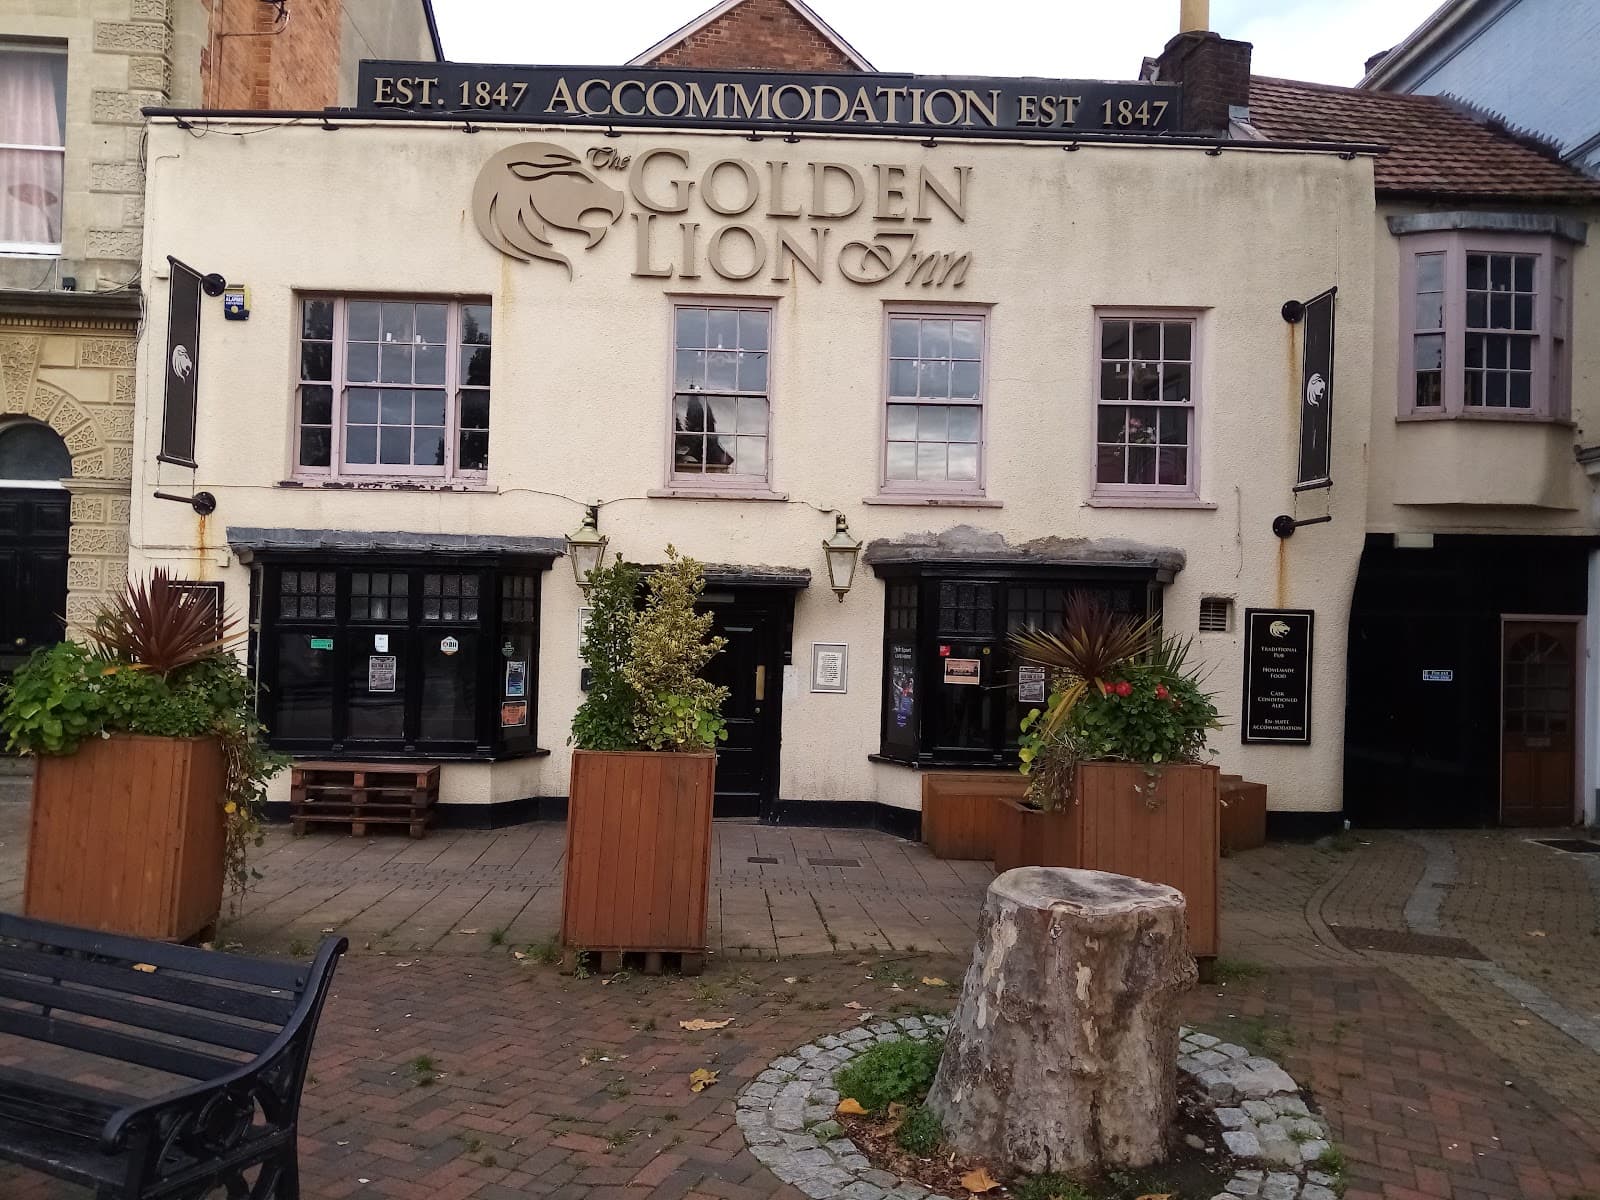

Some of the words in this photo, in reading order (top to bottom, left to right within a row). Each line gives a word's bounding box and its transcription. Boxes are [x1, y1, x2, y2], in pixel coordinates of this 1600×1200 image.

[373, 77, 444, 105] EST.
[459, 80, 529, 107] 1847
[544, 77, 1001, 127] ACCOMMODATION
[1017, 95, 1081, 125] EST
[1102, 99, 1169, 127] 1847
[586, 147, 632, 171] The
[628, 147, 973, 223] GOLDEN
[630, 212, 831, 283] LION
[837, 228, 973, 287] Inn
